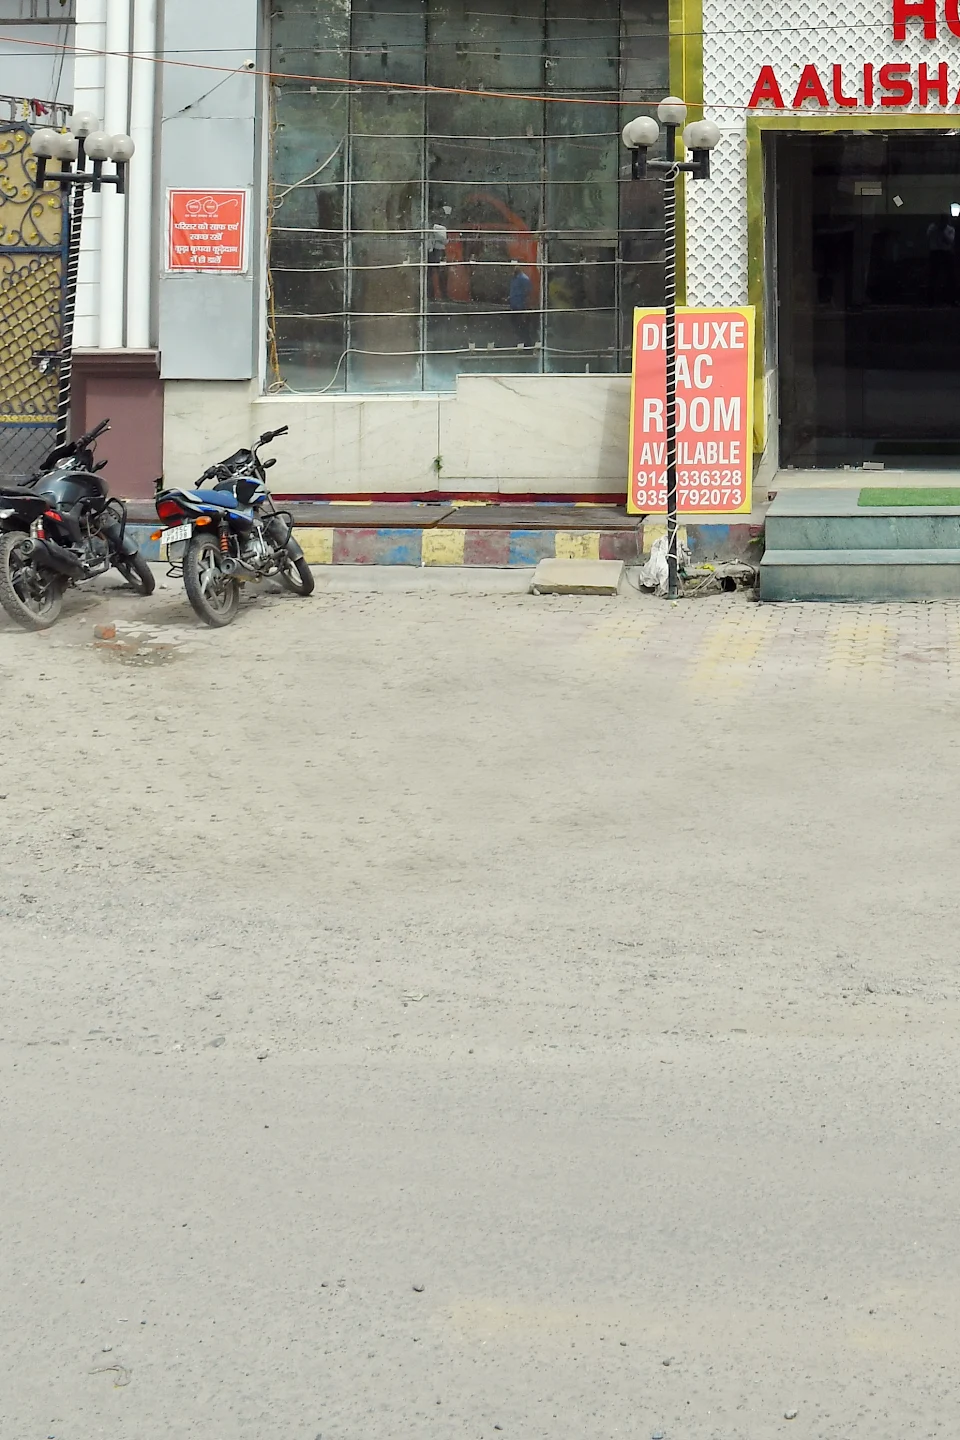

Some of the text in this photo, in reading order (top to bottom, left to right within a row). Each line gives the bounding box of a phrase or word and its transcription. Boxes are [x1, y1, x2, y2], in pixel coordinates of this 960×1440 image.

[642, 321, 745, 351] DLUXE
[675, 354, 713, 389] AC
[640, 441, 740, 466] AVILABLE
[637, 469, 742, 487] 914336328
[637, 489, 742, 506] 935792073
